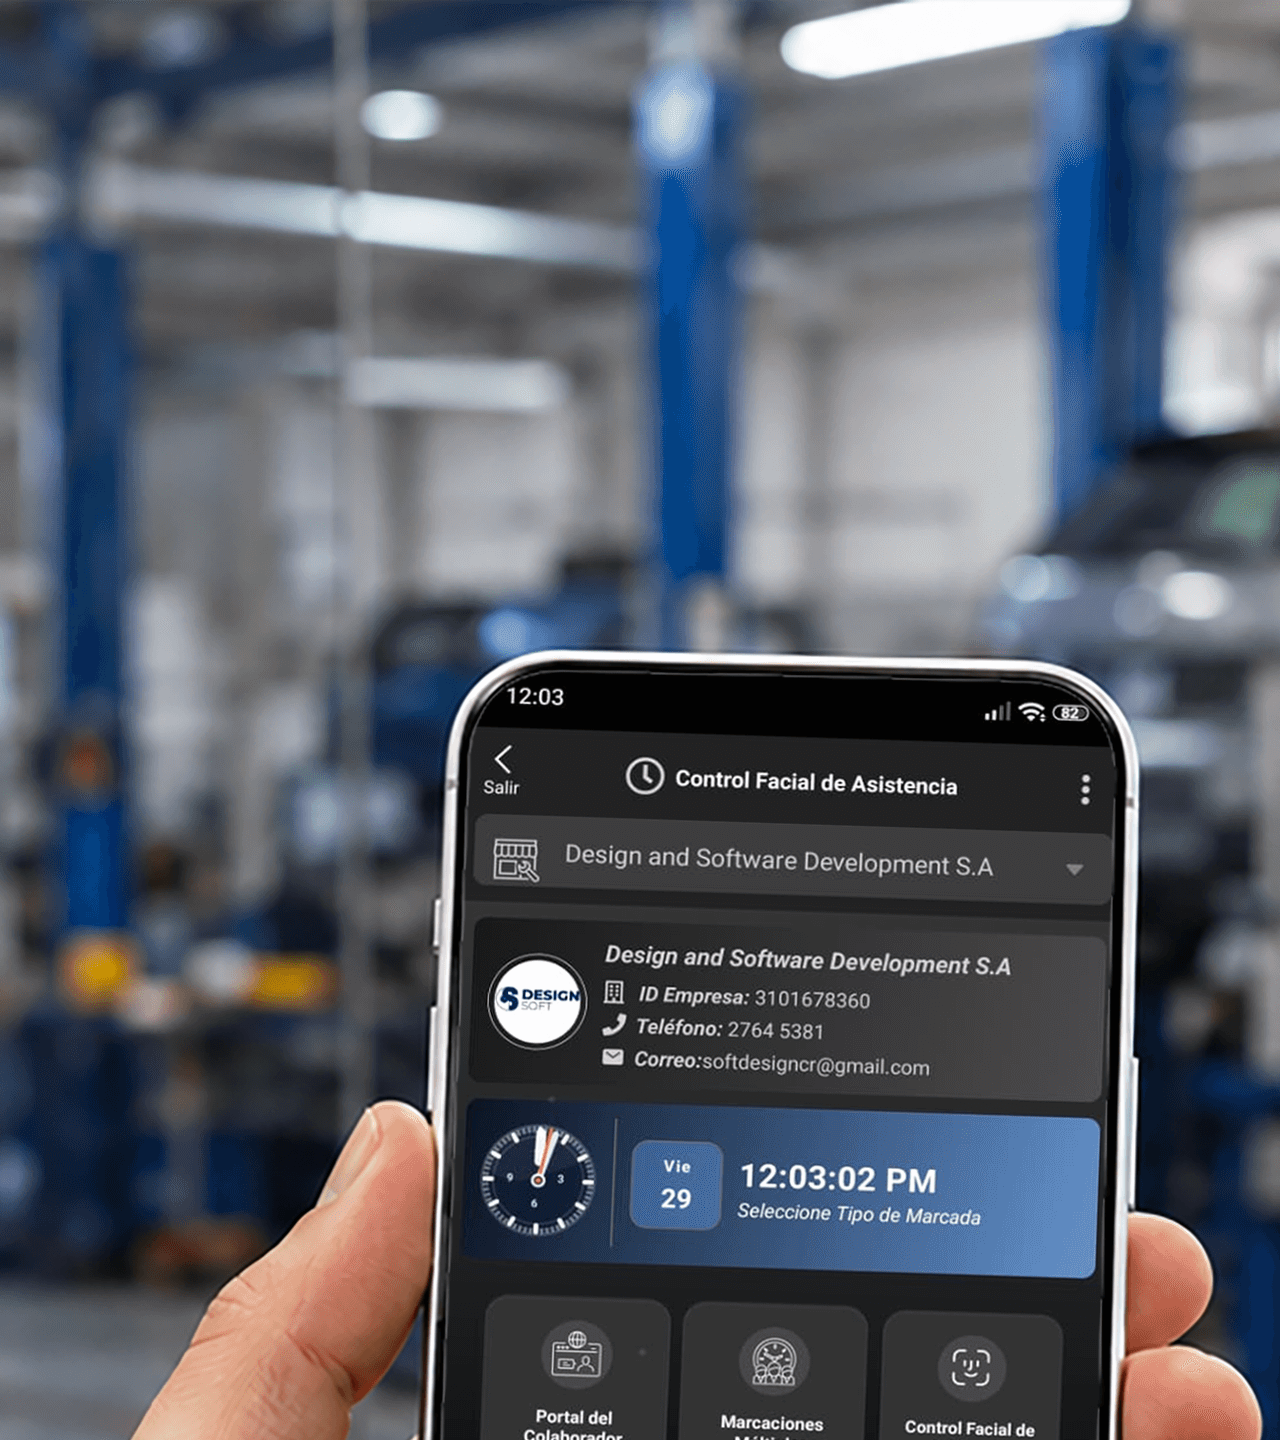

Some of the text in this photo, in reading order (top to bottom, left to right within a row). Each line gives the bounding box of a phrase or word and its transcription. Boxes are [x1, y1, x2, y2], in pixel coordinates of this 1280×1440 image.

[506, 687, 564, 706] 12:03
[1060, 706, 1080, 720] 82
[483, 779, 520, 795] Salir
[675, 769, 958, 796] Control Facial de Asistencia
[565, 843, 994, 878] Design and Software Development S.A
[604, 944, 1011, 977] Design and Software Development S.A
[522, 988, 580, 1002] DESIGN
[639, 985, 871, 1010] ID Empresa: 3101678360
[521, 1001, 552, 1011] SOFT
[637, 1017, 823, 1040] Teléfono: 2764 5381
[663, 1159, 691, 1174] Vie
[506, 1172, 514, 1182] 9
[557, 1173, 565, 1184] 3
[741, 1163, 936, 1194] 12:03:02 PM
[530, 1198, 538, 1208] 6
[661, 1187, 692, 1210] 29
[737, 1202, 982, 1226] Seleccione Tipo de Marcada
[535, 1409, 613, 1426] Portal del
[720, 1414, 824, 1433] Marcaciones
[905, 1419, 1036, 1438] Control Facial de
